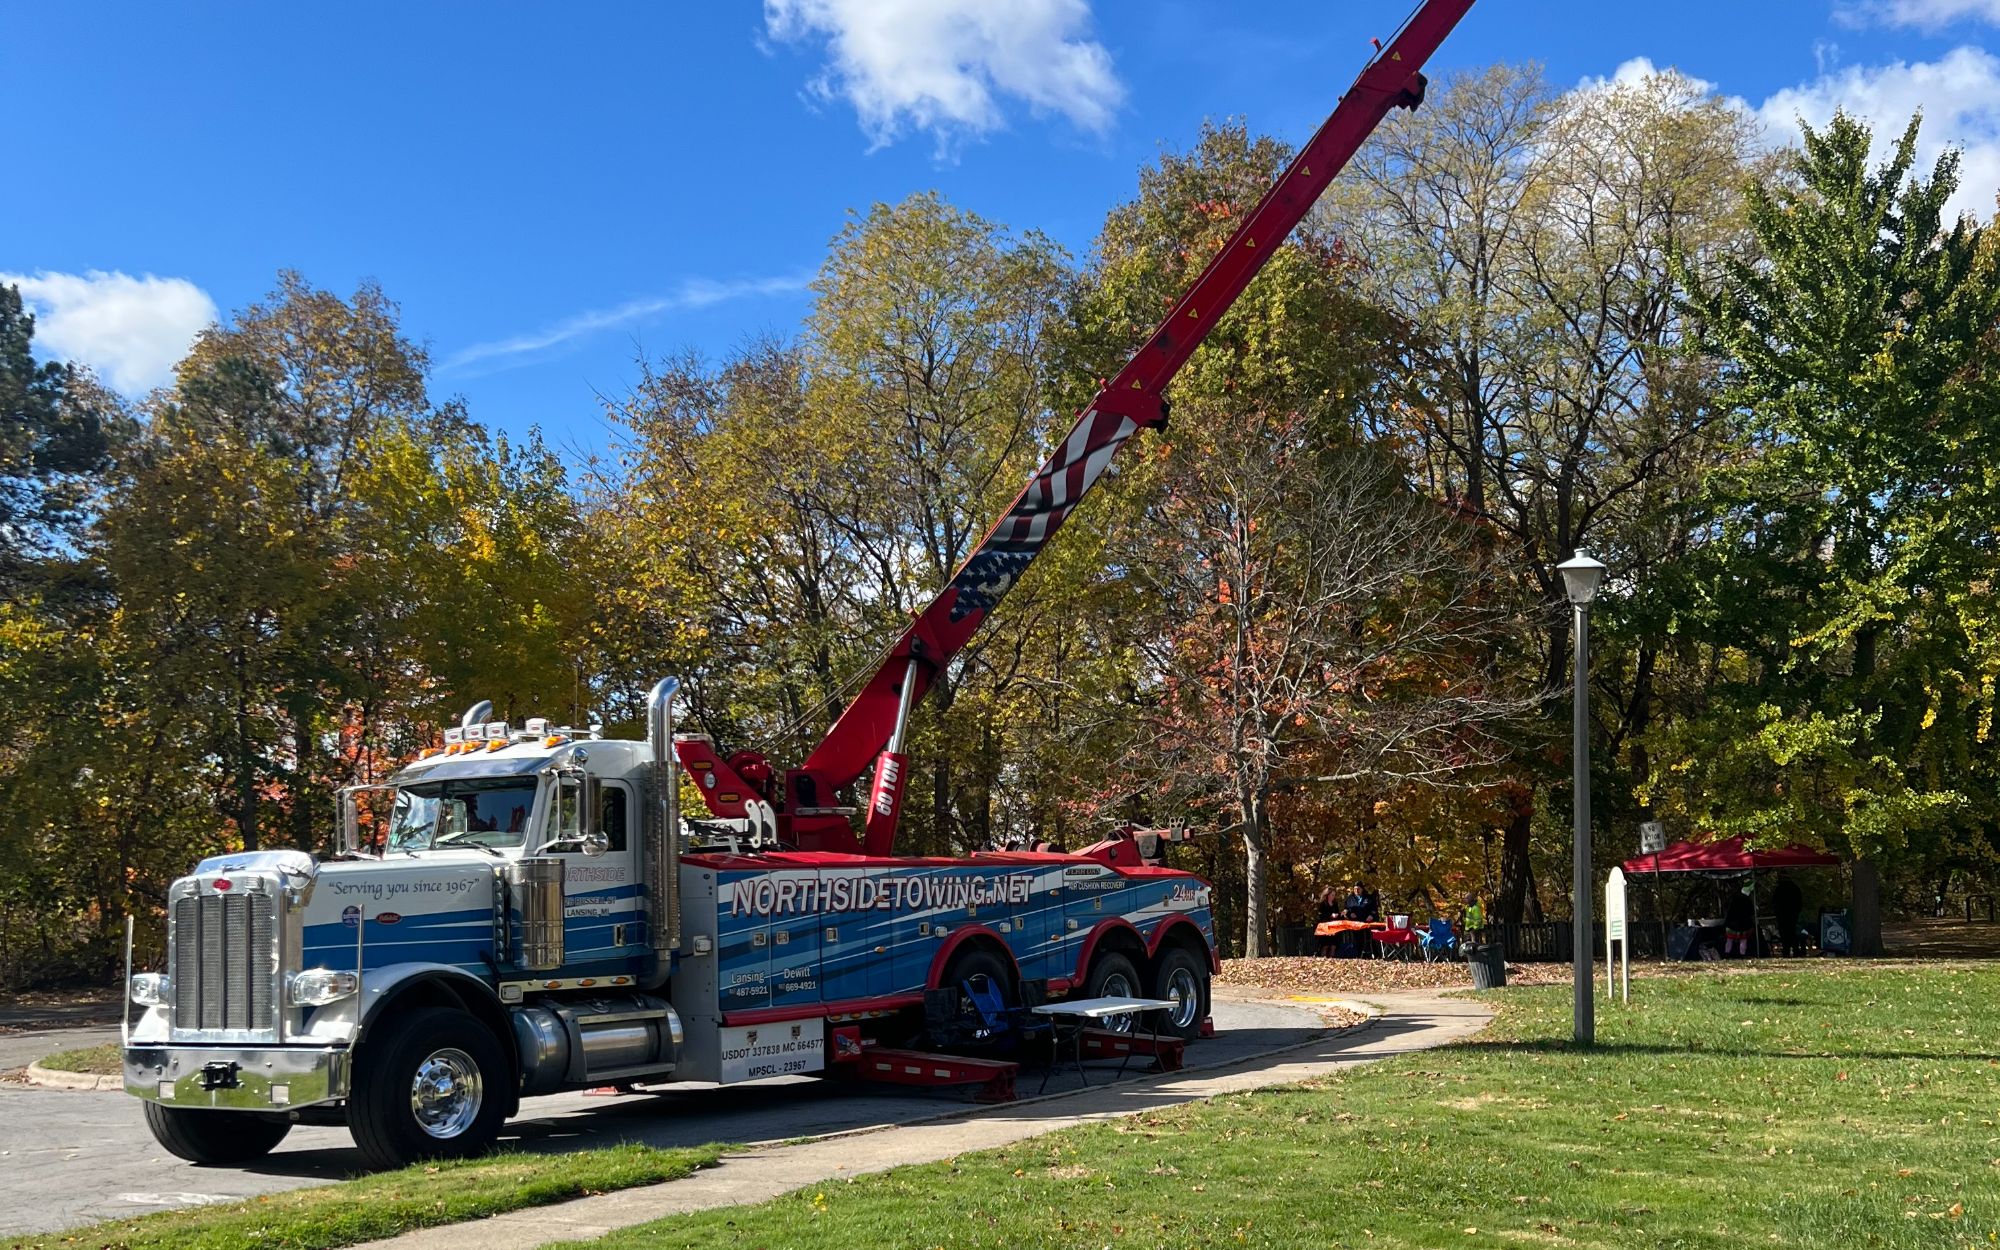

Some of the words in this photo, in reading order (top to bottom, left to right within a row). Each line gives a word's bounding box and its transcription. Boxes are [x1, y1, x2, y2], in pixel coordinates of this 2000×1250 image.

[880, 757, 900, 791] TON
[876, 791, 894, 816] 60
[565, 866, 626, 882] RTHSIDE
[387, 883, 410, 900] you
[413, 880, 442, 893] since
[1101, 881, 1126, 890] RECOVERY
[731, 875, 1034, 918] NORTHSIDETOWING.NET
[731, 972, 765, 984] Lansing
[783, 966, 811, 979] Dewitt
[722, 1048, 751, 1061] USDOT
[783, 1042, 796, 1052] MC
[748, 1063, 777, 1077] MPSCL
